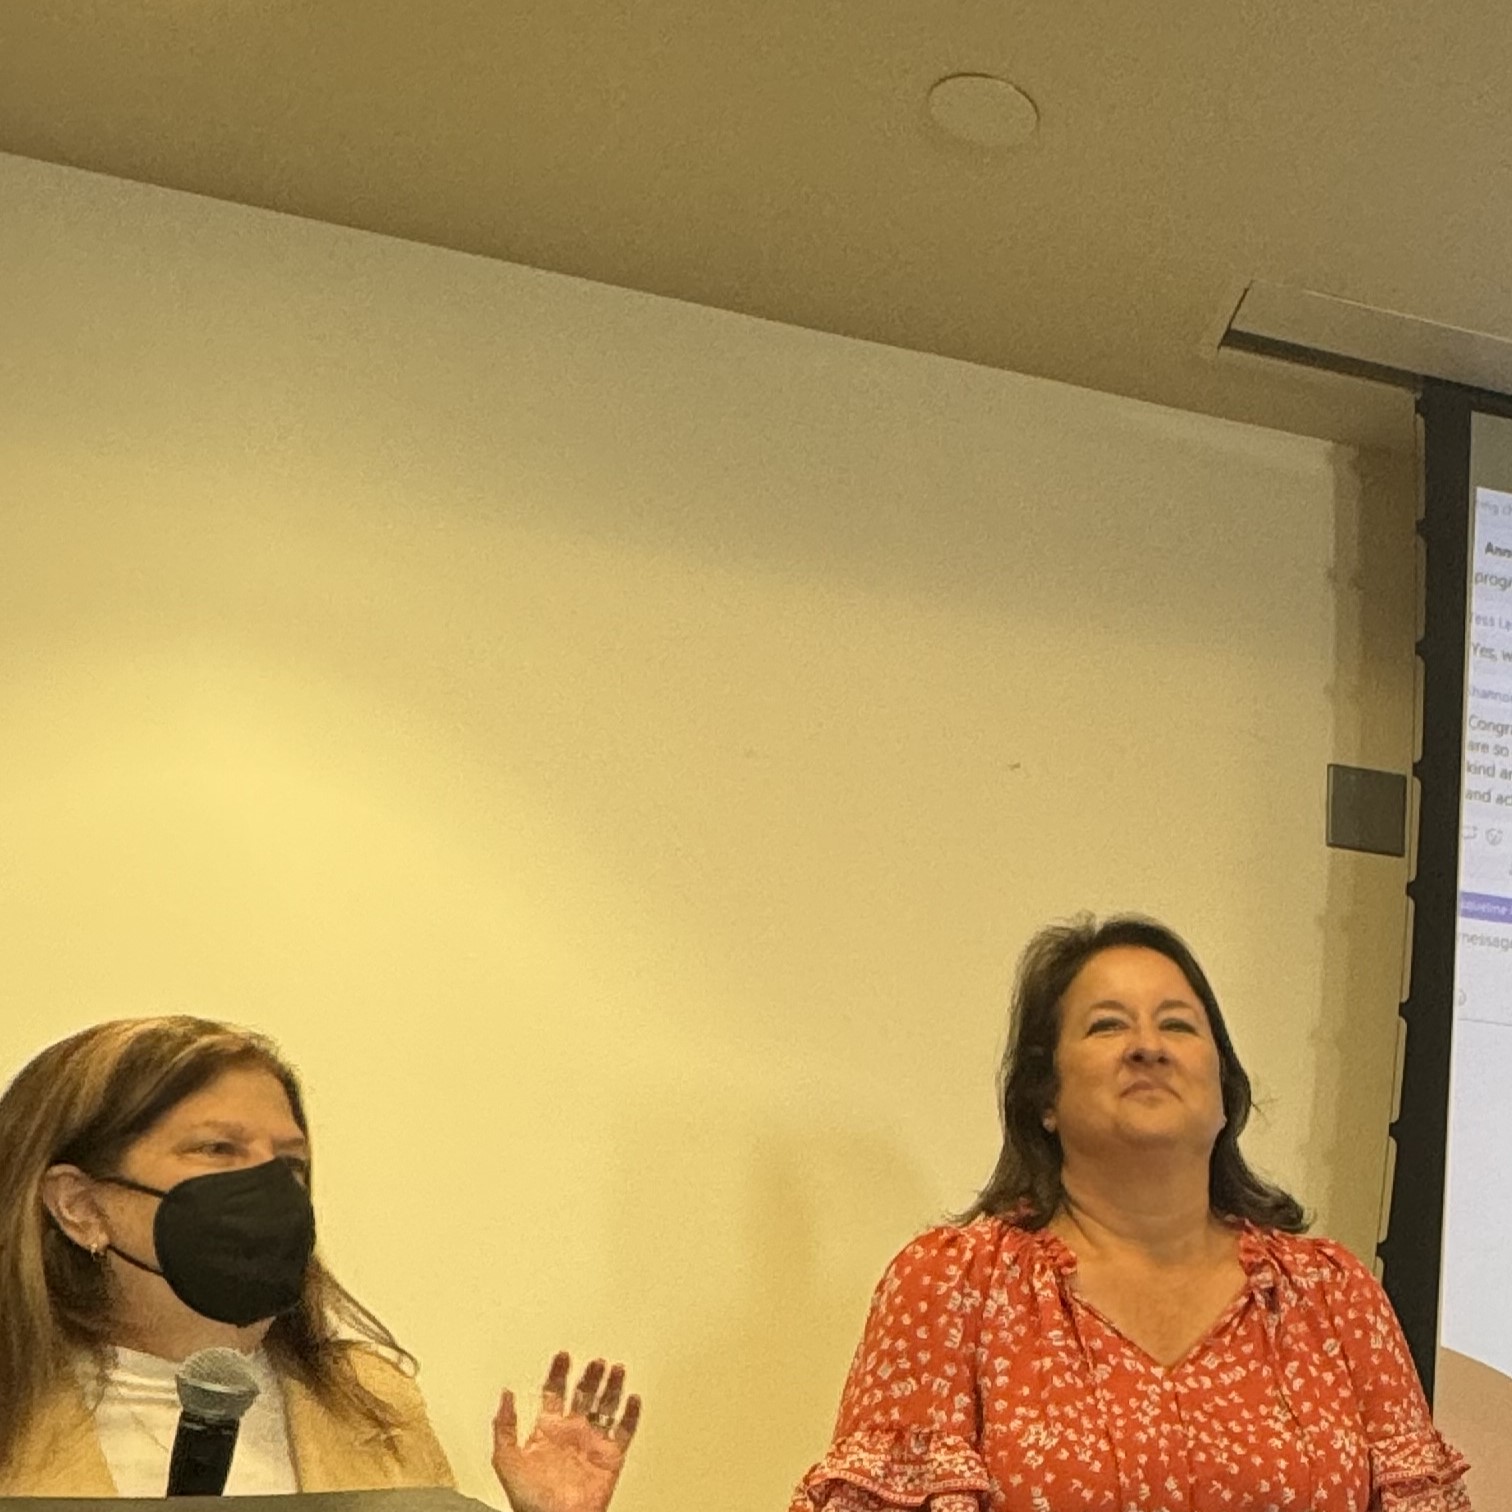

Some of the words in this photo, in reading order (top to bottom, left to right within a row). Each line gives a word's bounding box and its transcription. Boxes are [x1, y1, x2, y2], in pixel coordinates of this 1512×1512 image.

[1472, 642, 1498, 661] Yes,
[1467, 741, 1489, 755] are
[1493, 745, 1510, 758] so
[1467, 761, 1496, 778] kind
[1465, 788, 1492, 803] and
